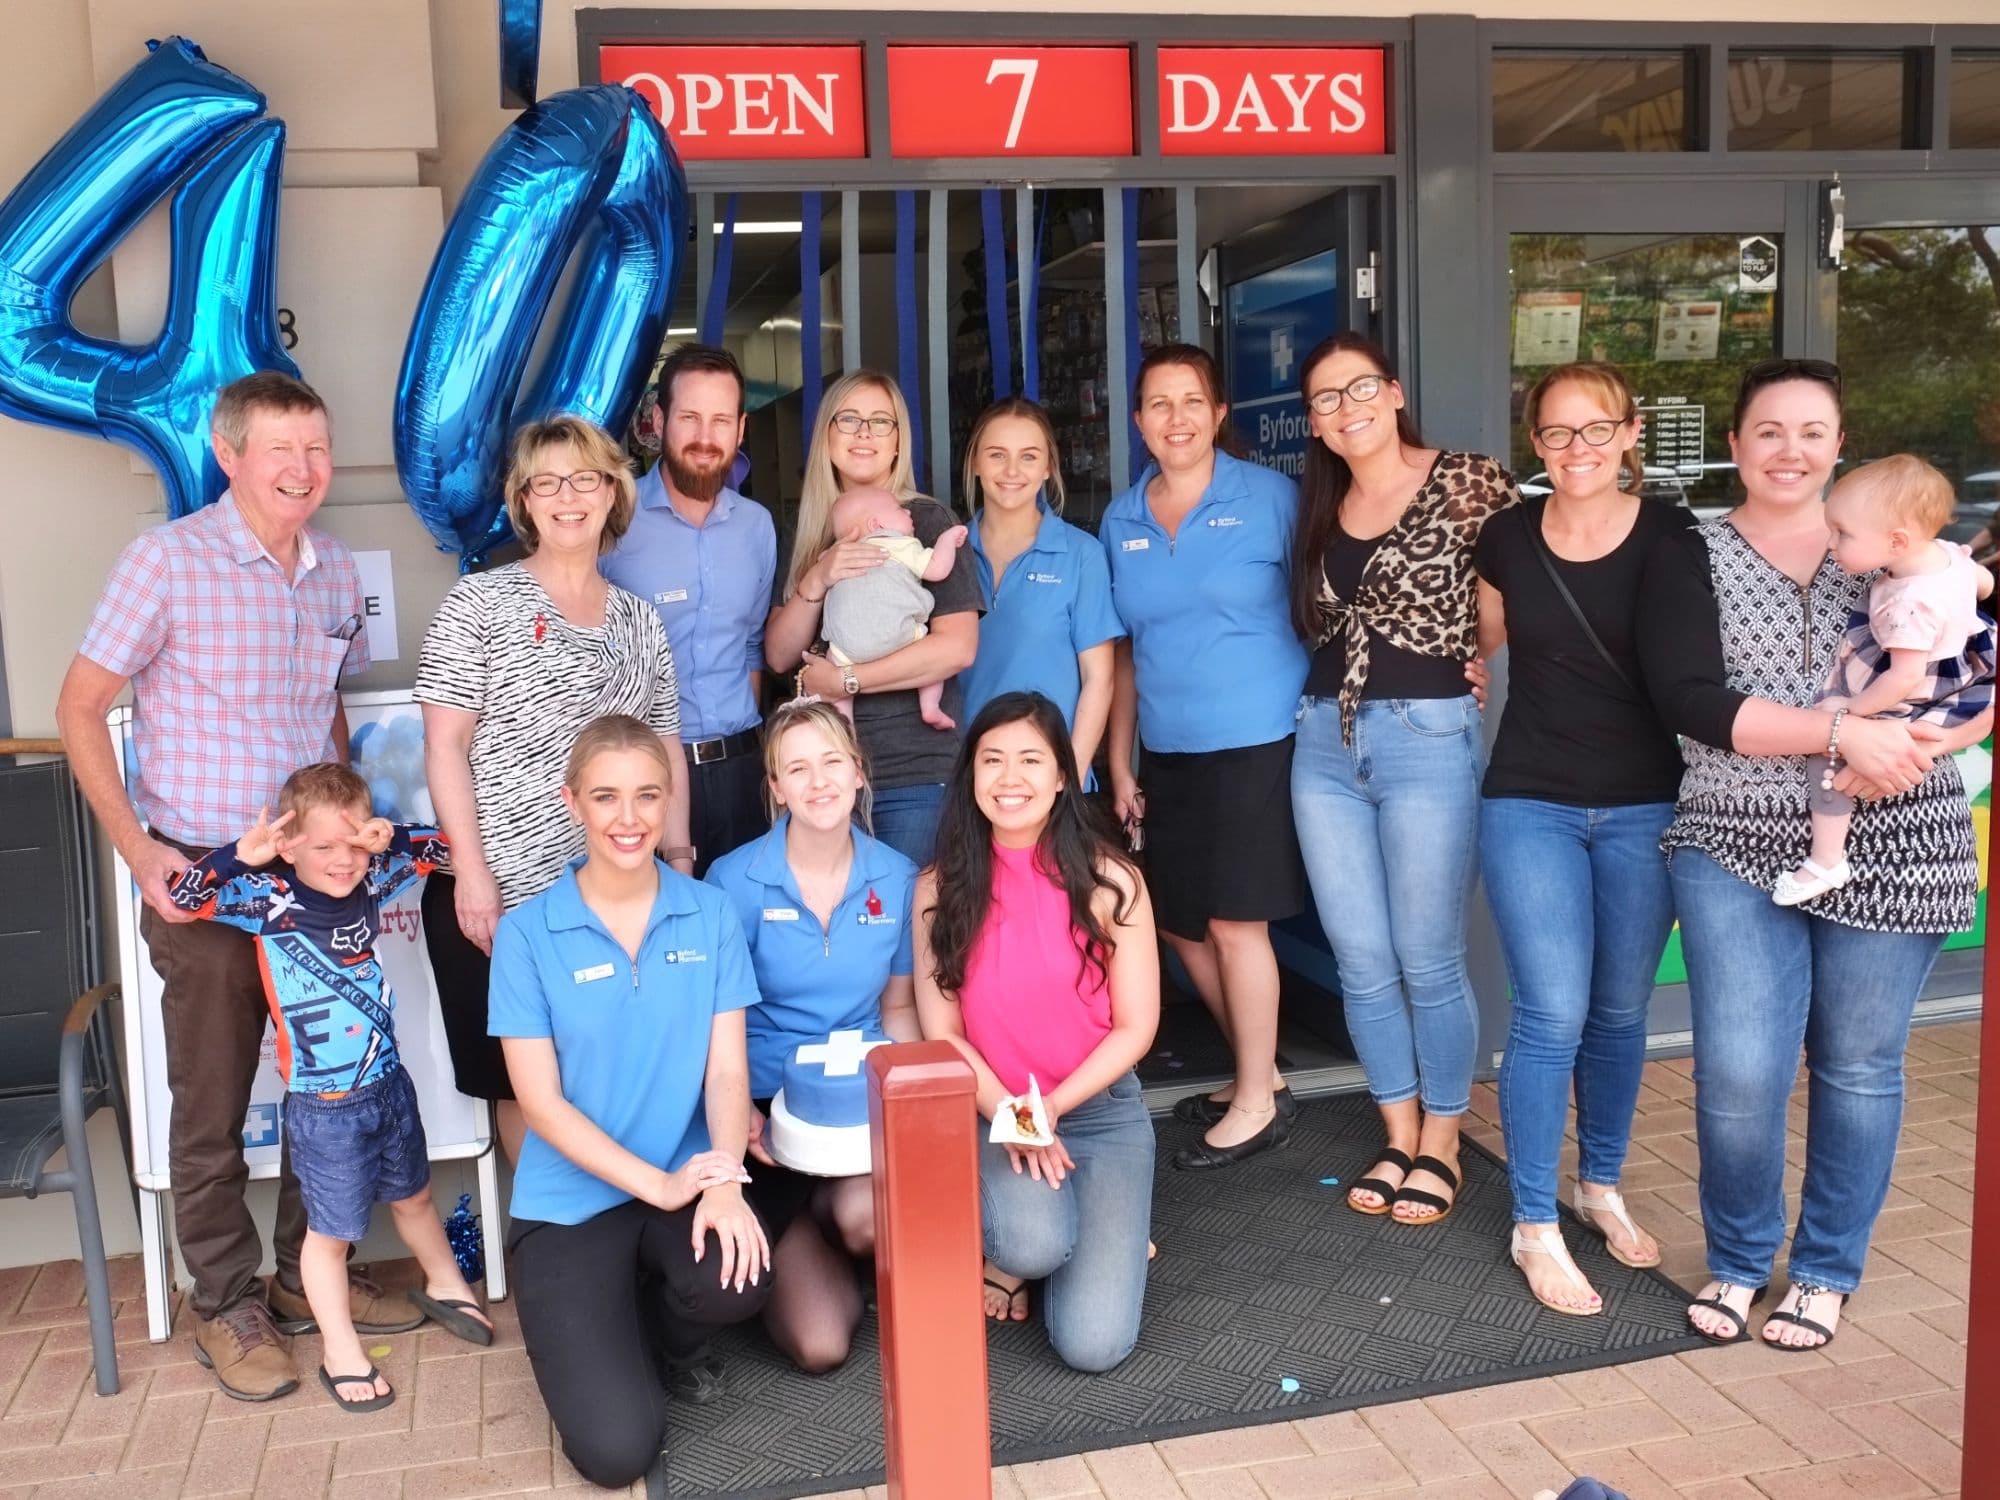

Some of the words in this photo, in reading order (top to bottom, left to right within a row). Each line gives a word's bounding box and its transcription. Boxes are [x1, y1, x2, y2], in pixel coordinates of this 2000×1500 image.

[619, 72, 839, 137] OPEN
[985, 58, 1039, 149] 7
[1166, 71, 1367, 134] DAYS
[378, 903, 420, 942] rty
